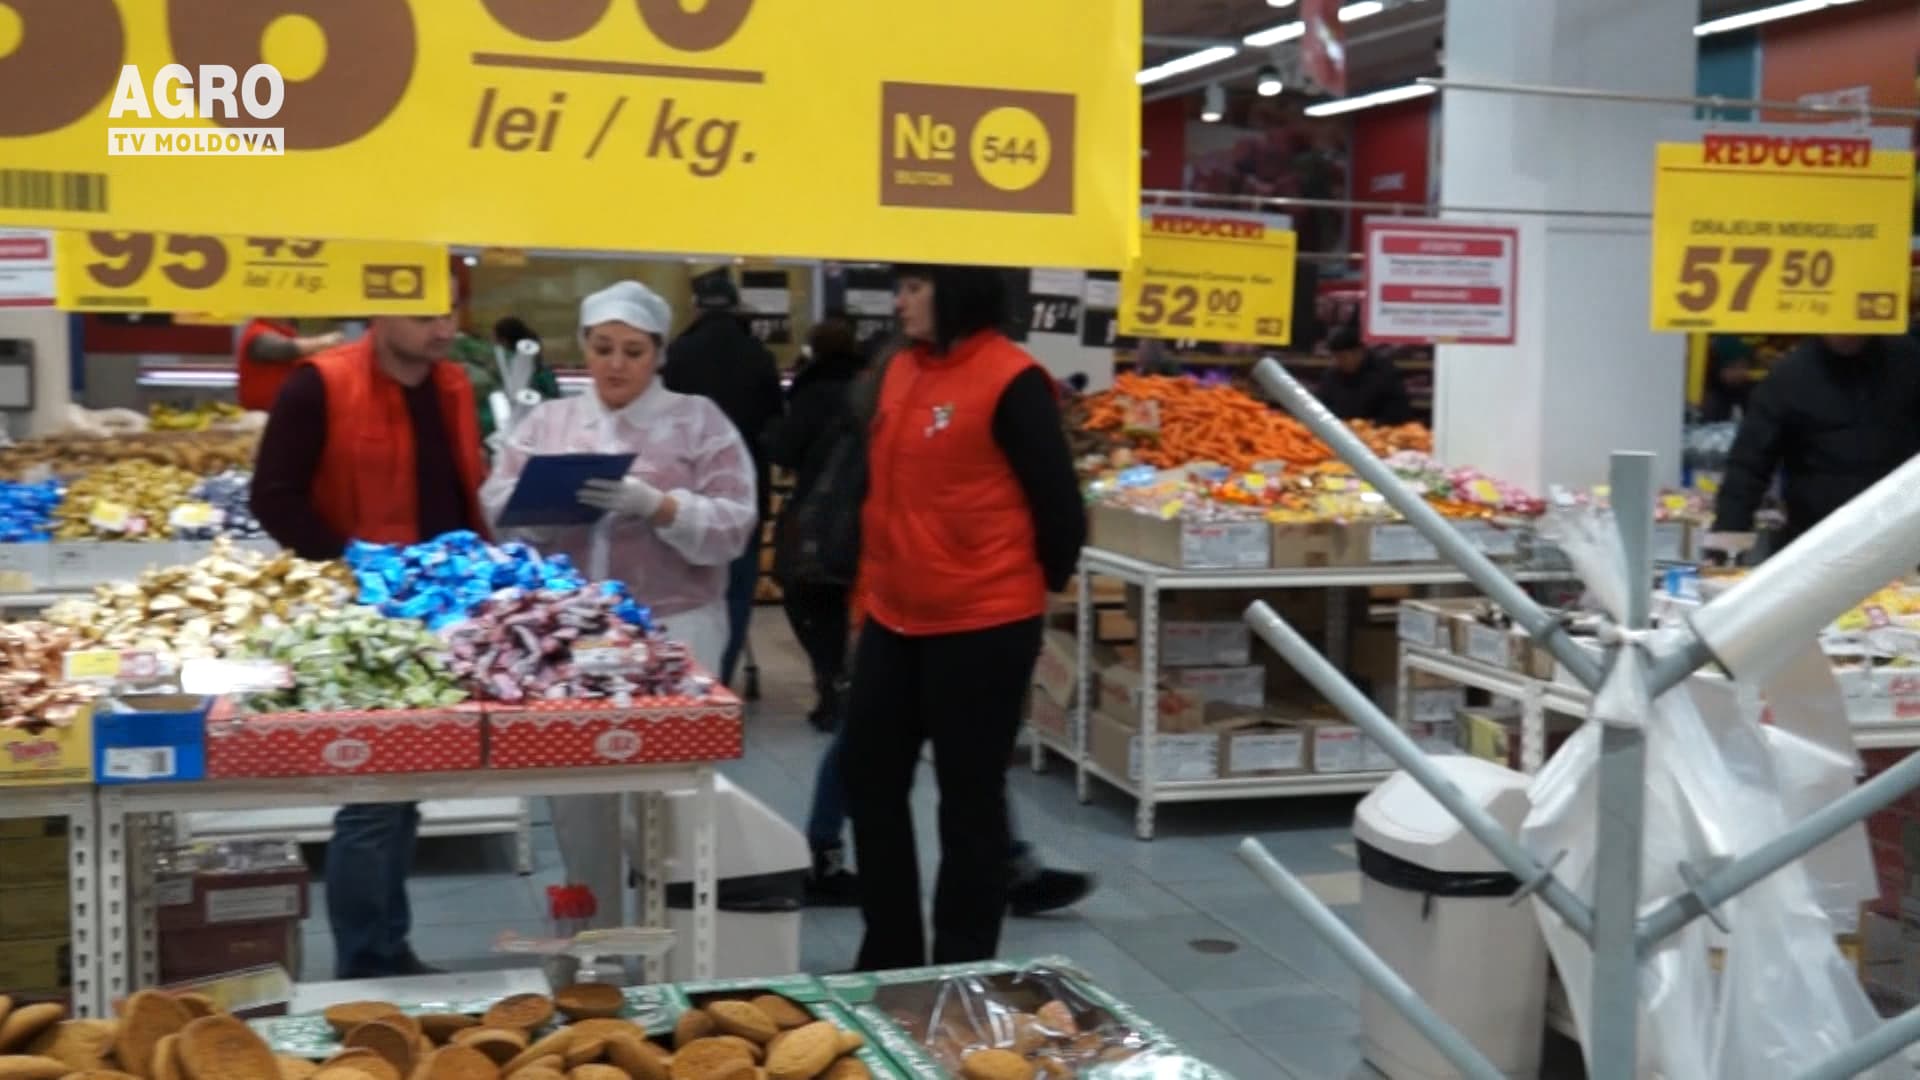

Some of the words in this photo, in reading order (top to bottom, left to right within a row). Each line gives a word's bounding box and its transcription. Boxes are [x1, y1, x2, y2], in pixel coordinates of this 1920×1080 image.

[469, 87, 567, 152] lei
[583, 96, 628, 159] /
[645, 98, 756, 178] kg.
[982, 136, 1038, 164] 544
[1703, 135, 1872, 168] REDUCERI
[1675, 245, 1773, 313] 57
[1780, 250, 1835, 288] 50
[1135, 283, 1199, 326] 52
[1207, 288, 1243, 314] 00
